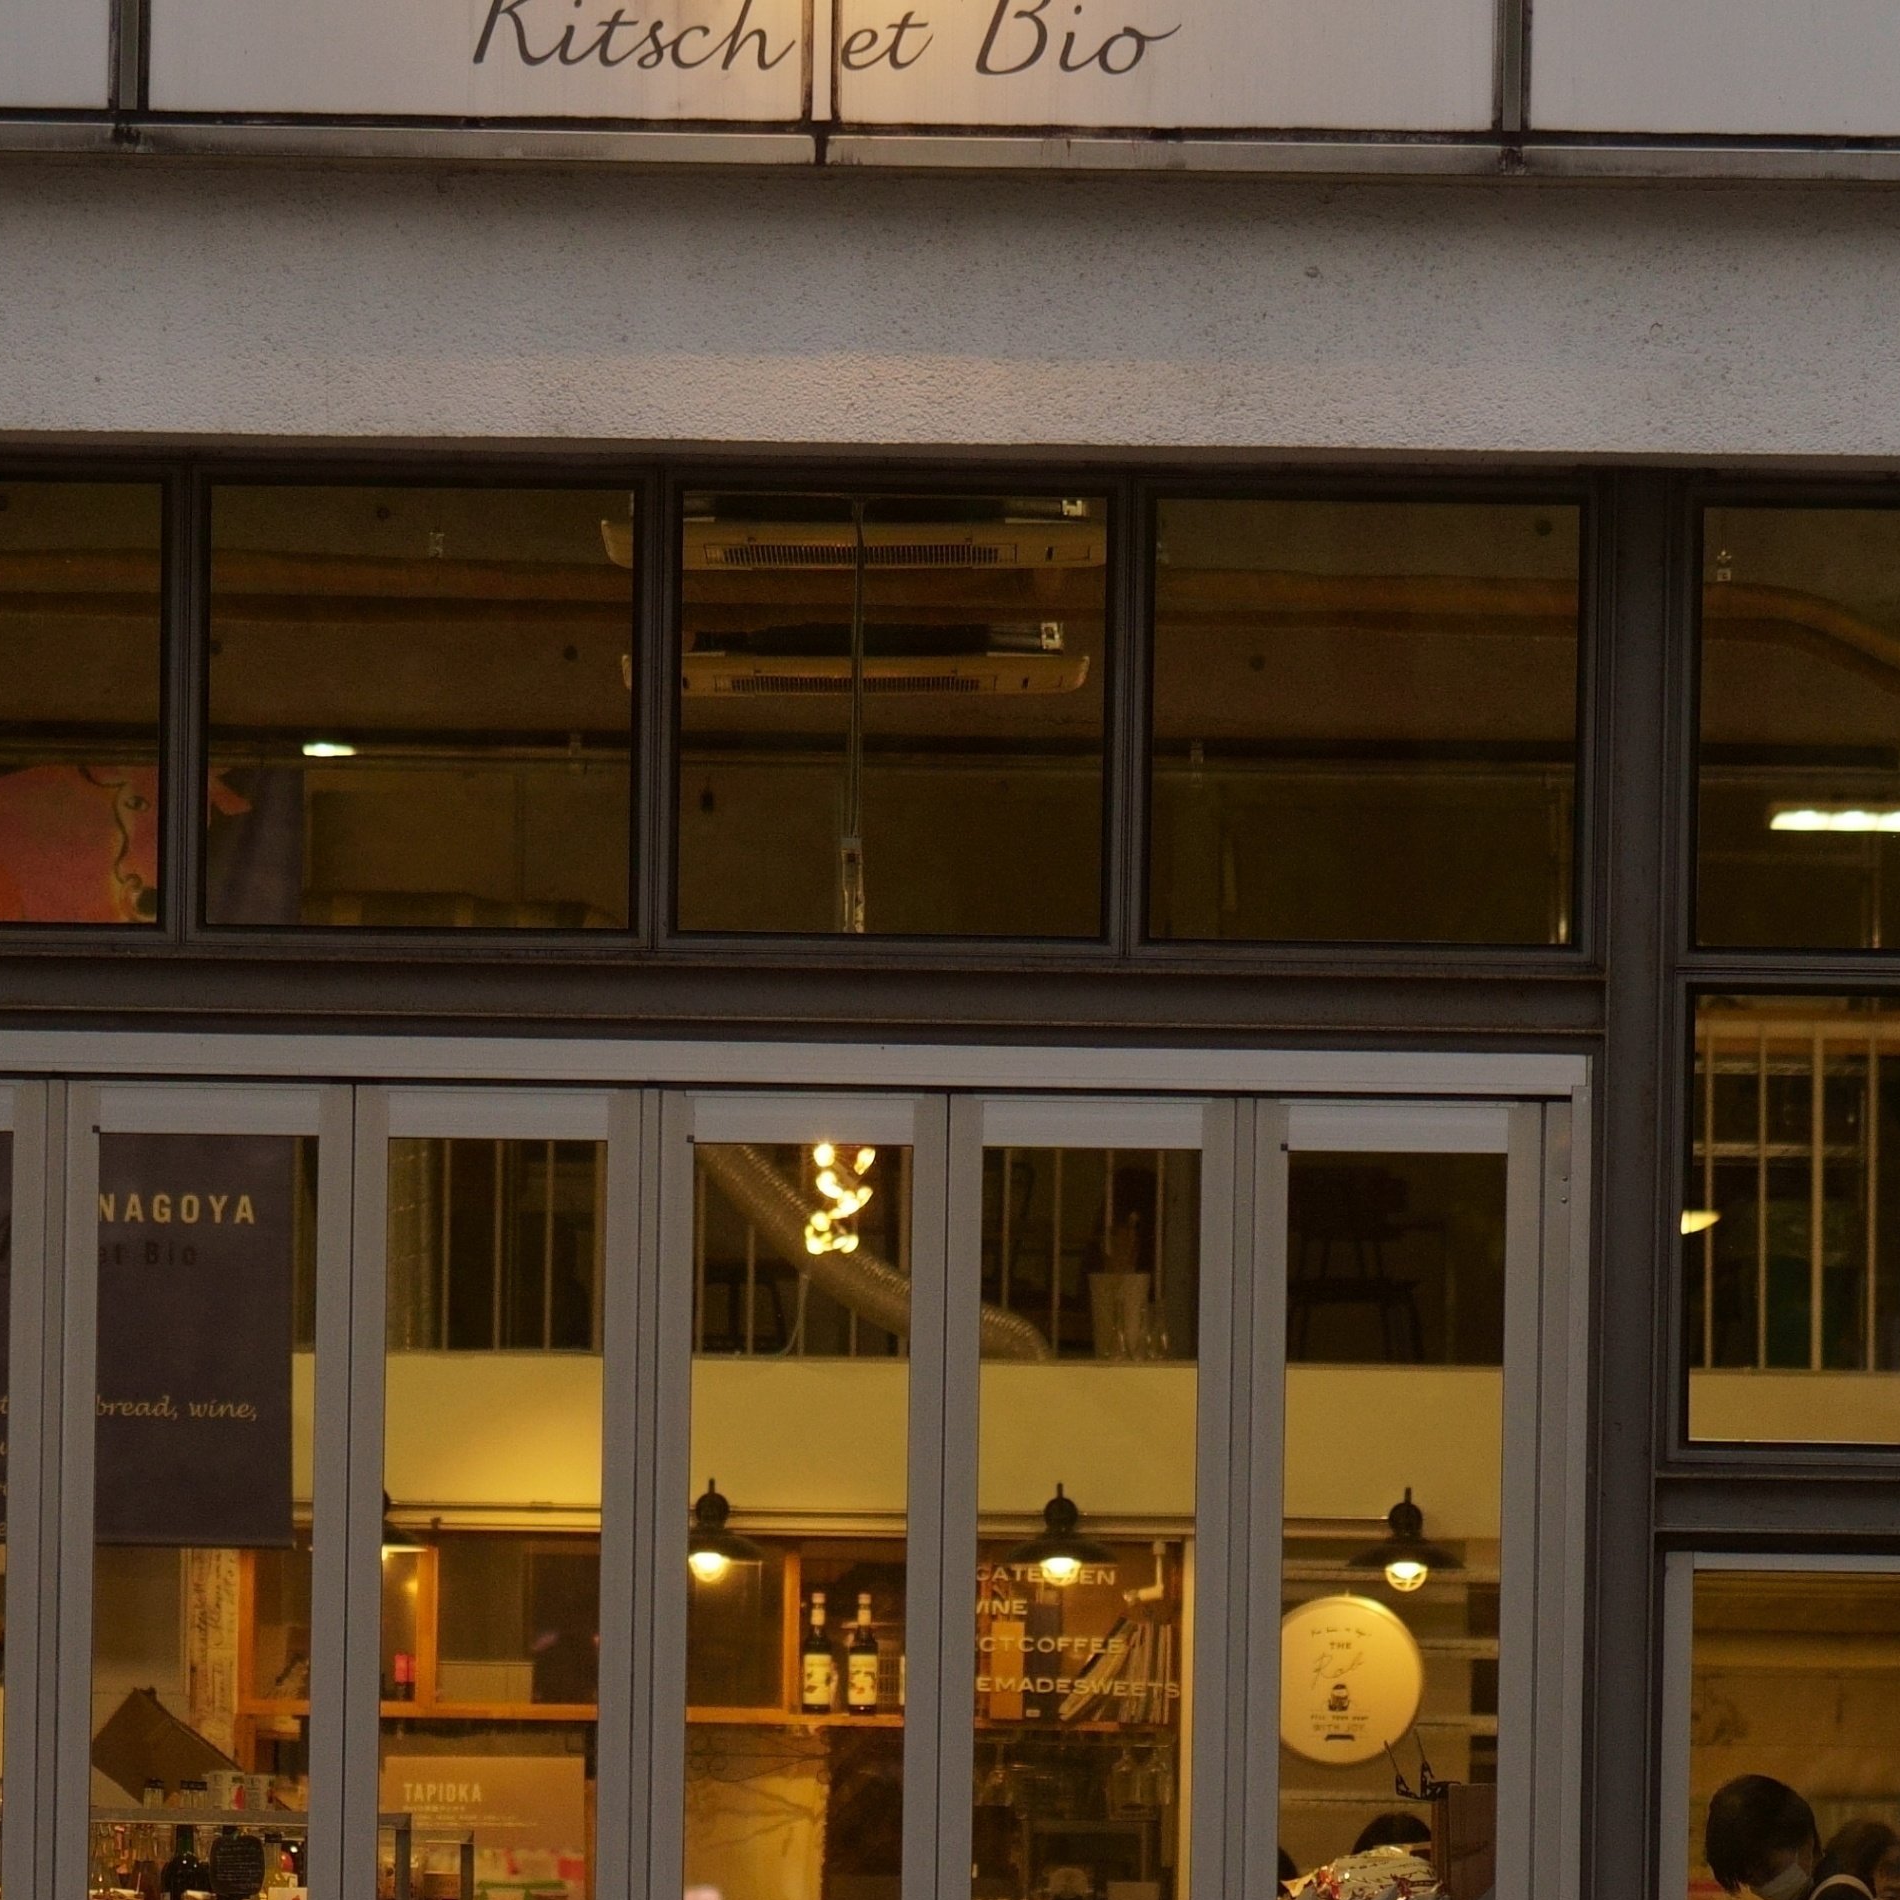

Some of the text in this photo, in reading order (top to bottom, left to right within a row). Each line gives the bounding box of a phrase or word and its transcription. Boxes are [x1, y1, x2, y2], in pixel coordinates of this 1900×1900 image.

[473, 0, 1182, 75] Kitsch et Bio
[99, 1192, 256, 1225] NAGOYA
[96, 1394, 179, 1421] bread,
[188, 1399, 258, 1422] wine,
[403, 1782, 483, 1803] TAPIOKA
